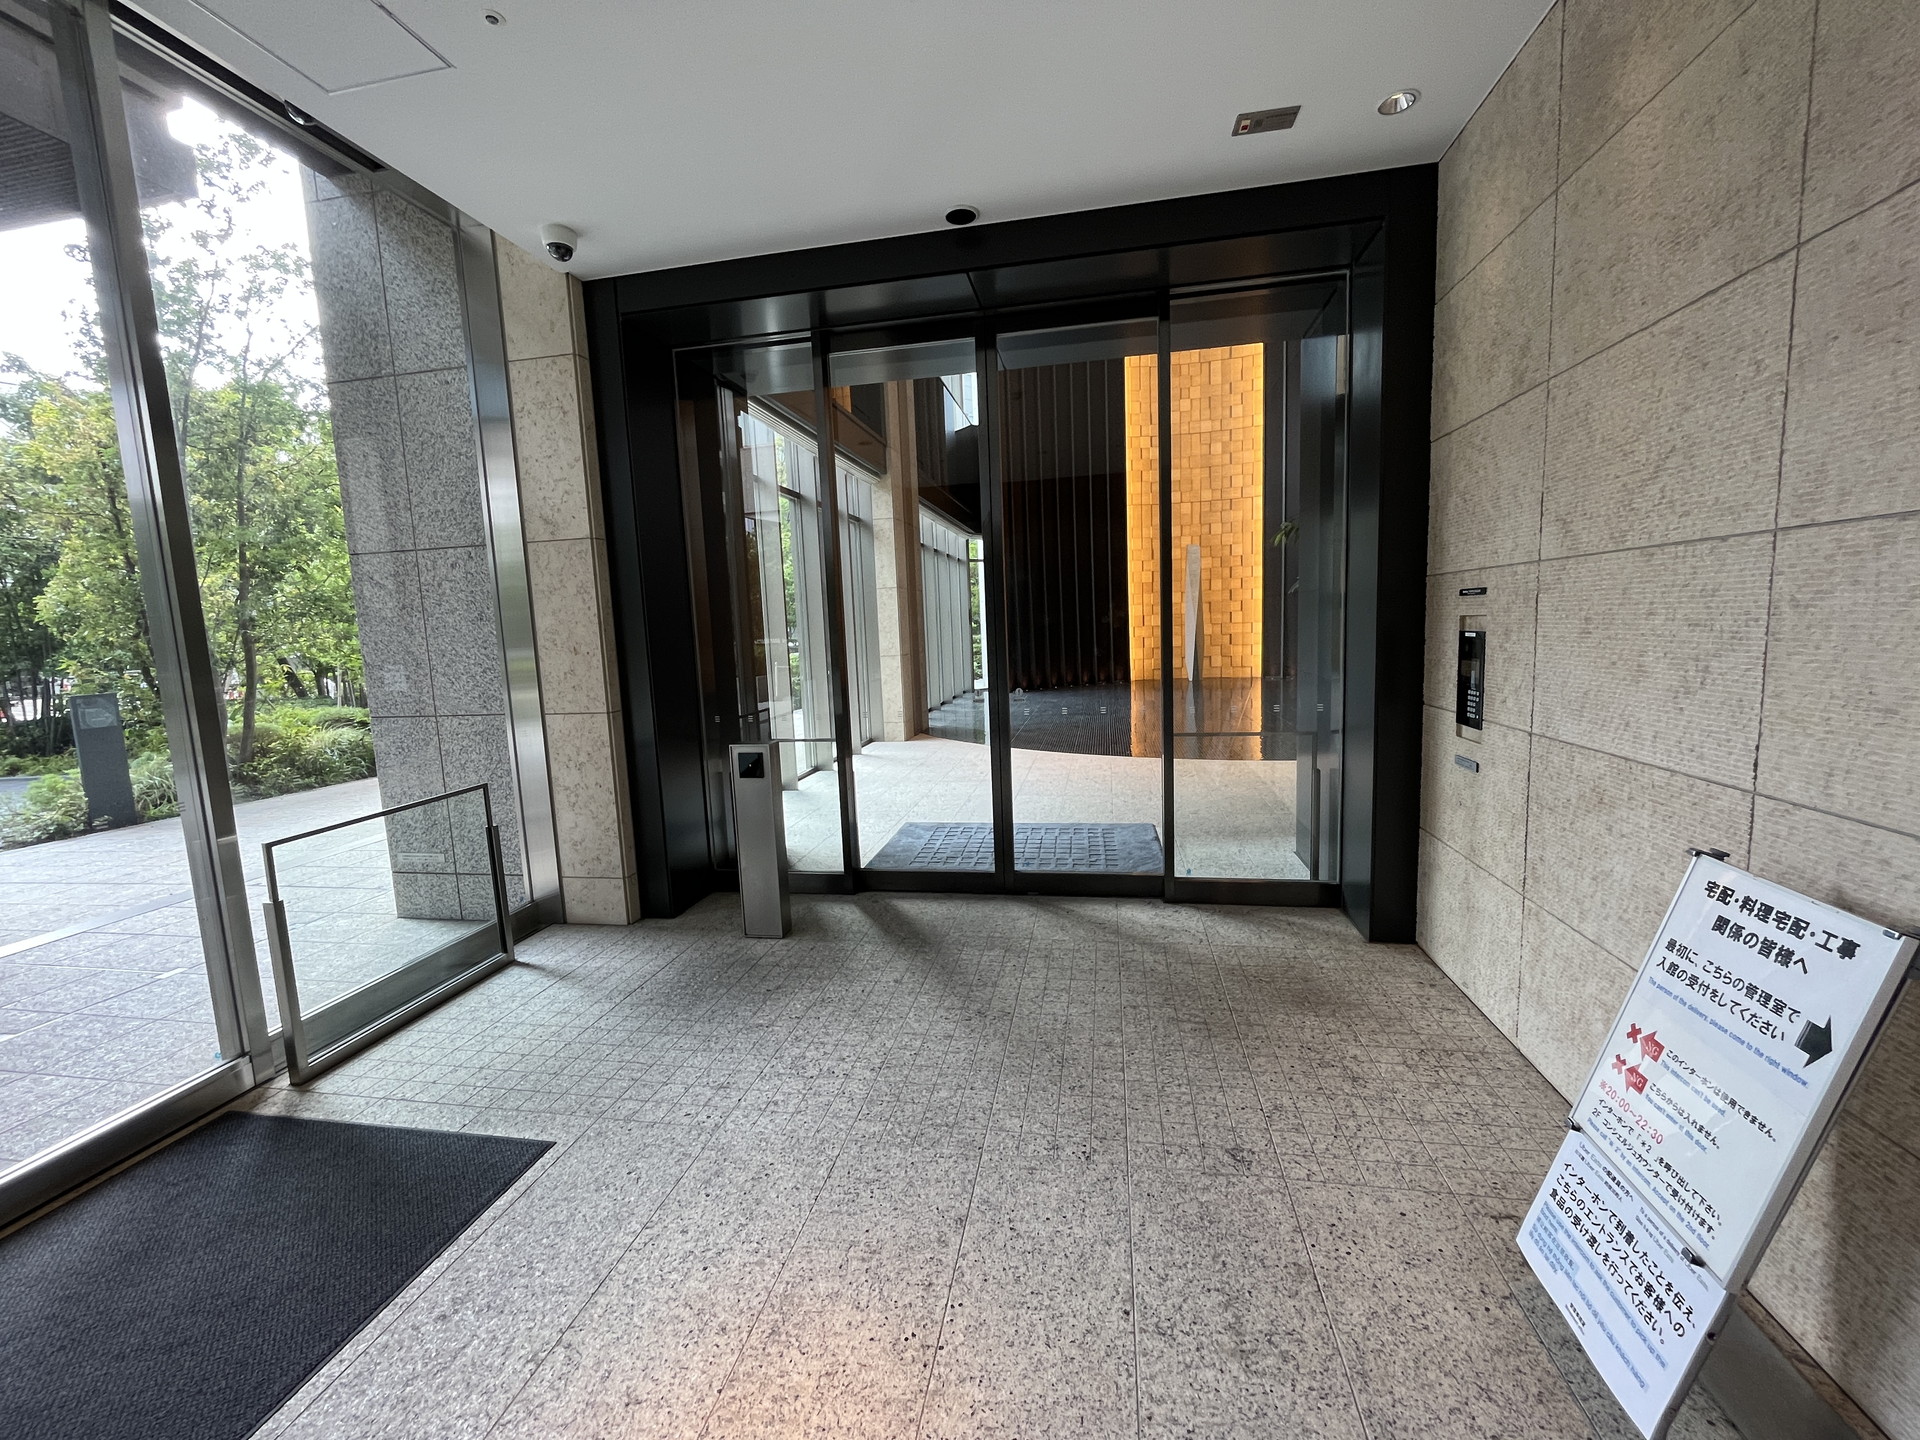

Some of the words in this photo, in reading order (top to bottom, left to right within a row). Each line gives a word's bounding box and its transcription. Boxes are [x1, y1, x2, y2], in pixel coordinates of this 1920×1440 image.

[1700, 878, 1863, 963] 宅配・料理宅配・工事
[1709, 913, 1814, 978] 関係の皆様へ
[1655, 954, 1788, 1045] 入館の受付をしてください
[1663, 937, 1802, 1026] 最初に、こちらの管理室で
[1644, 1040, 1660, 1057] NG
[1677, 995, 1688, 1007] the
[1727, 1029, 1746, 1047] come
[1744, 1040, 1754, 1052] to
[1752, 1045, 1765, 1059] the
[1763, 1052, 1782, 1070] right
[1629, 1071, 1644, 1088] NG
[1648, 1081, 1722, 1150] こちらからは入れません。
[1665, 1048, 1779, 1143] このインターホンは使用できません。
[1702, 1093, 1711, 1104] be
[1591, 1106, 1601, 1120] 2F
[1601, 1116, 1718, 1241] コンシェルジュカウンターで受け付けます。
[1683, 1128, 1695, 1141] this
[1548, 1185, 1668, 1346] 食品の受け渡しを行ってください。
[1554, 1172, 1686, 1341] こちらのエントランスでお客様への
[1561, 1159, 1700, 1329] インターホンで到着したことを伝え、
[1684, 1220, 1696, 1236] 2nd
[1563, 1227, 1572, 1240] the
[1588, 1261, 1595, 1270] to
[1601, 1278, 1611, 1292] the
[1629, 1318, 1637, 1329] to
[1634, 1326, 1648, 1345] pick
[1646, 1342, 1655, 1356] up
[1654, 1352, 1666, 1370] the
